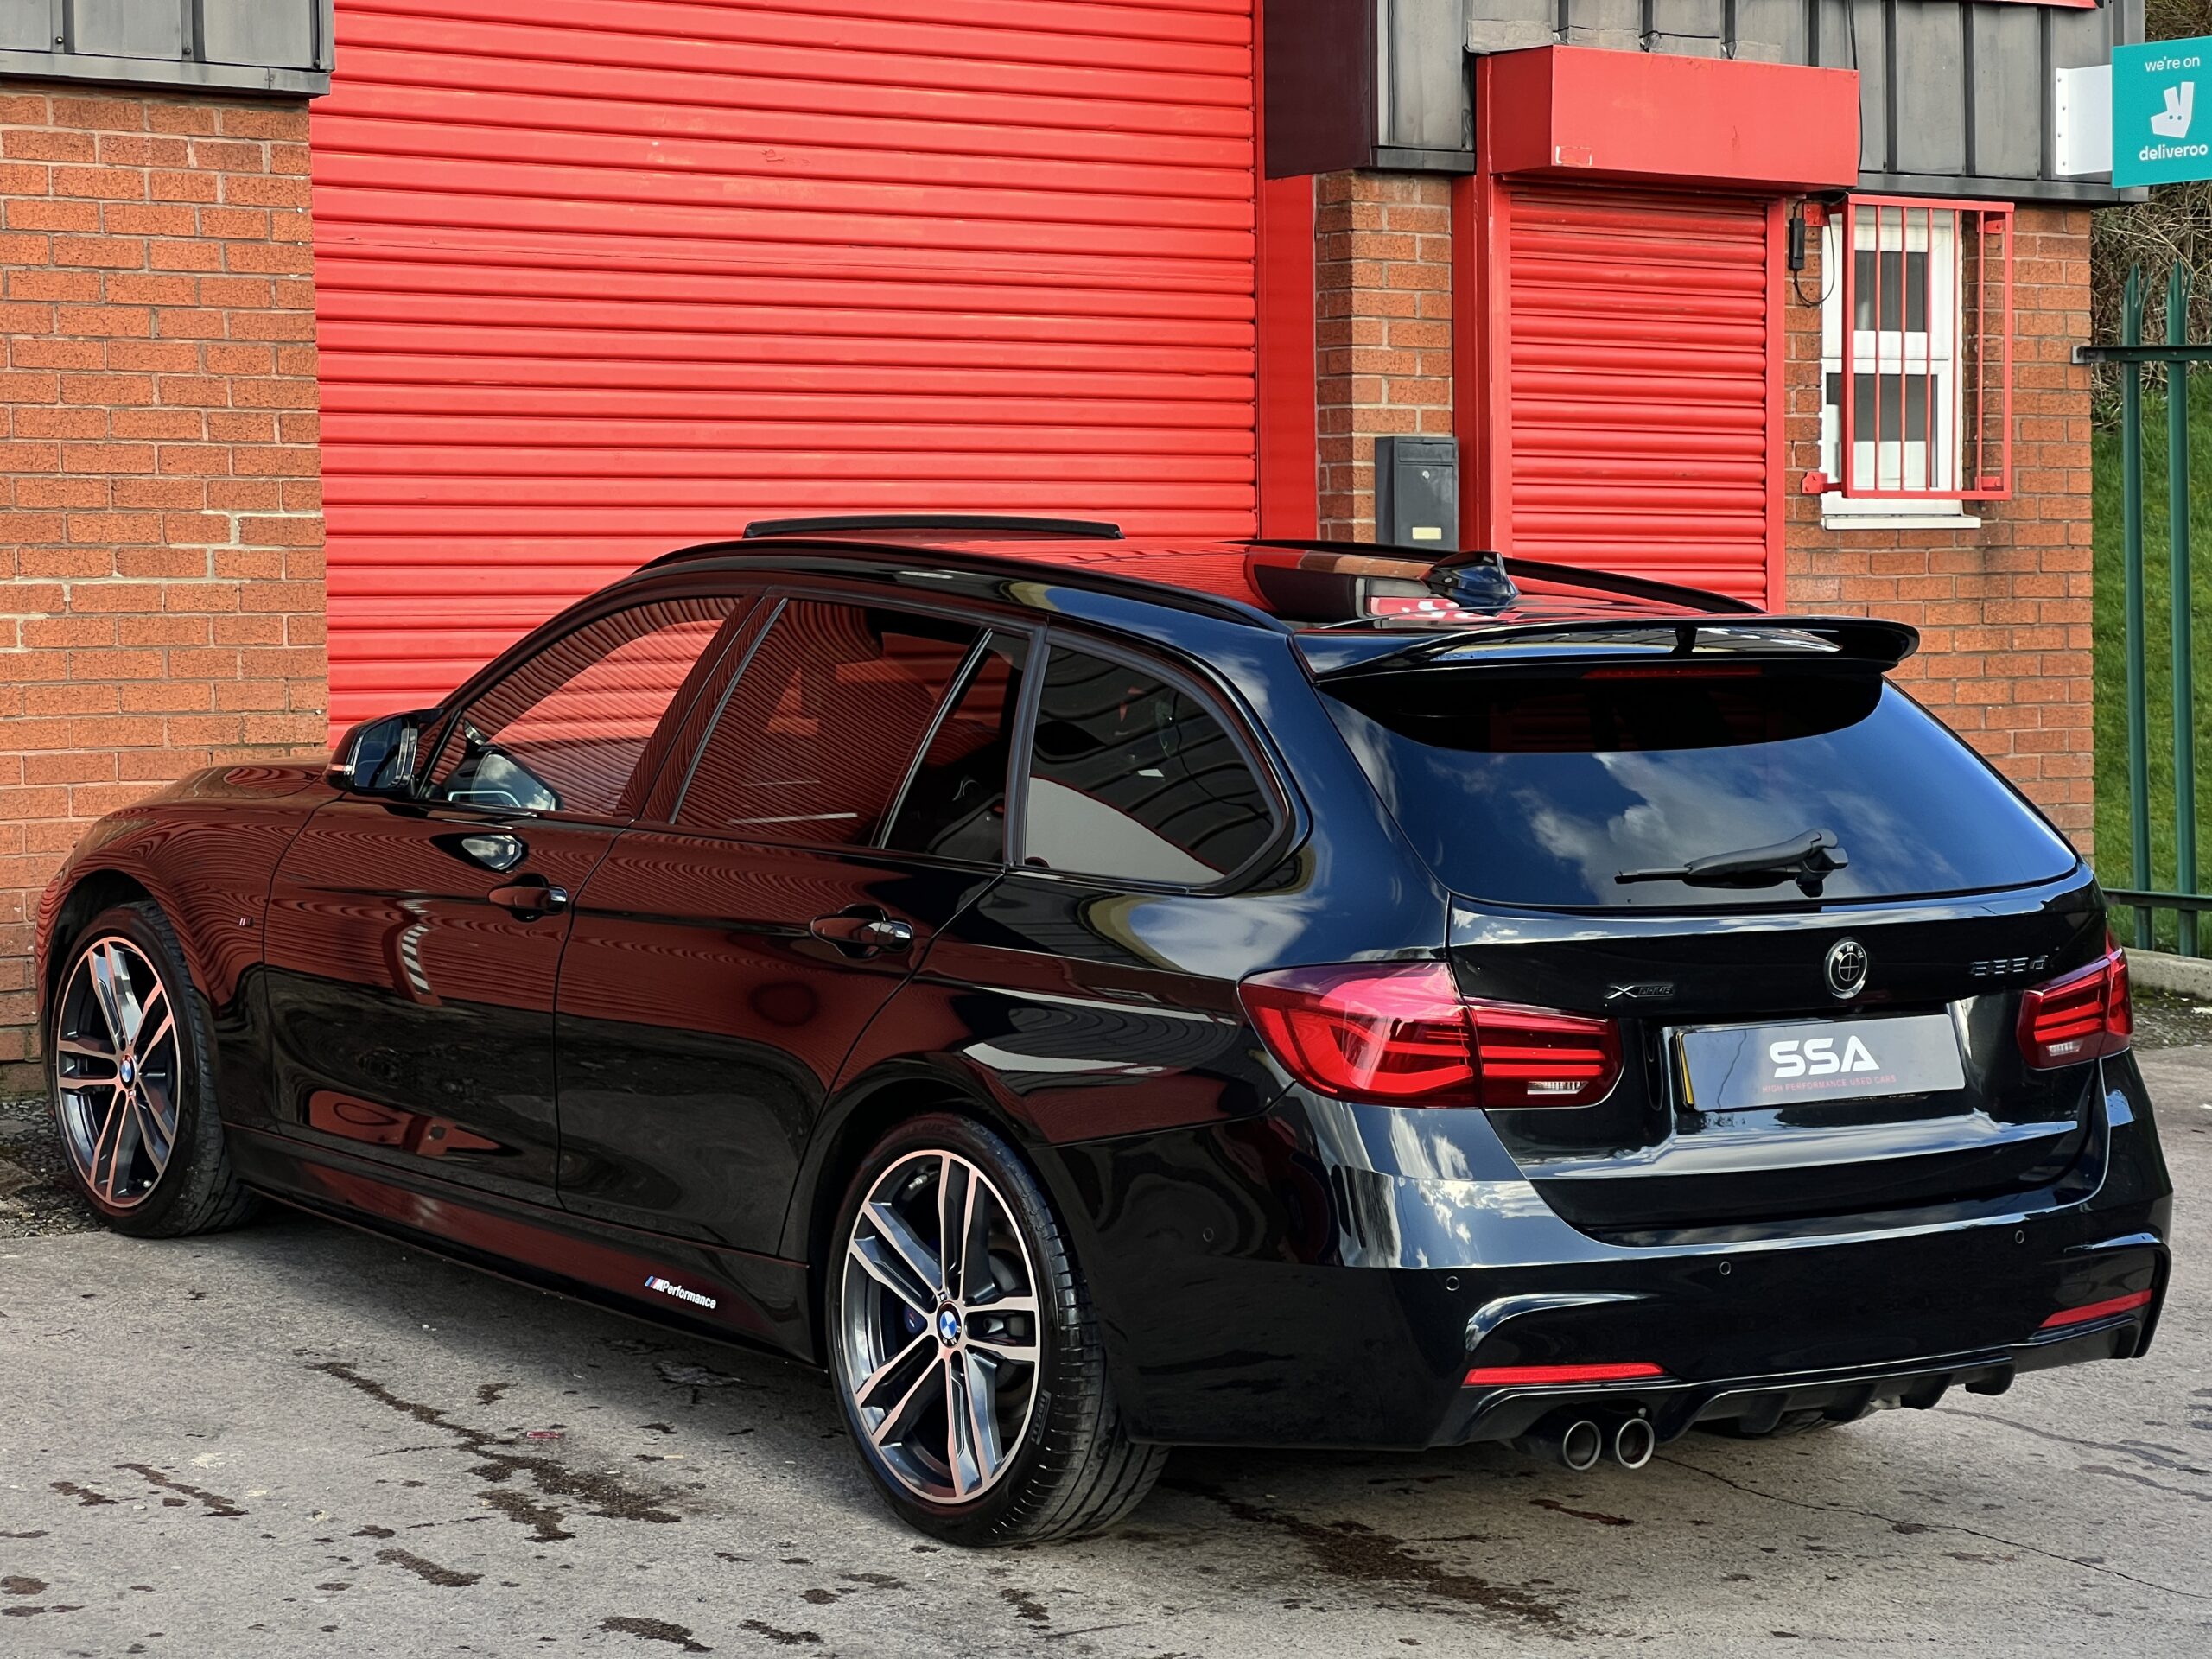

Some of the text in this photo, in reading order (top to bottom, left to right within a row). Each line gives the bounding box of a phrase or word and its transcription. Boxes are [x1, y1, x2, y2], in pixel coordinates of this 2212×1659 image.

[2145, 55, 2201, 73] we're on
[2139, 143, 2209, 162] deliveroo
[1769, 1035, 1880, 1078] SSA
[1762, 1074, 1897, 1093] HIGH PERFORMANCE USED CARS
